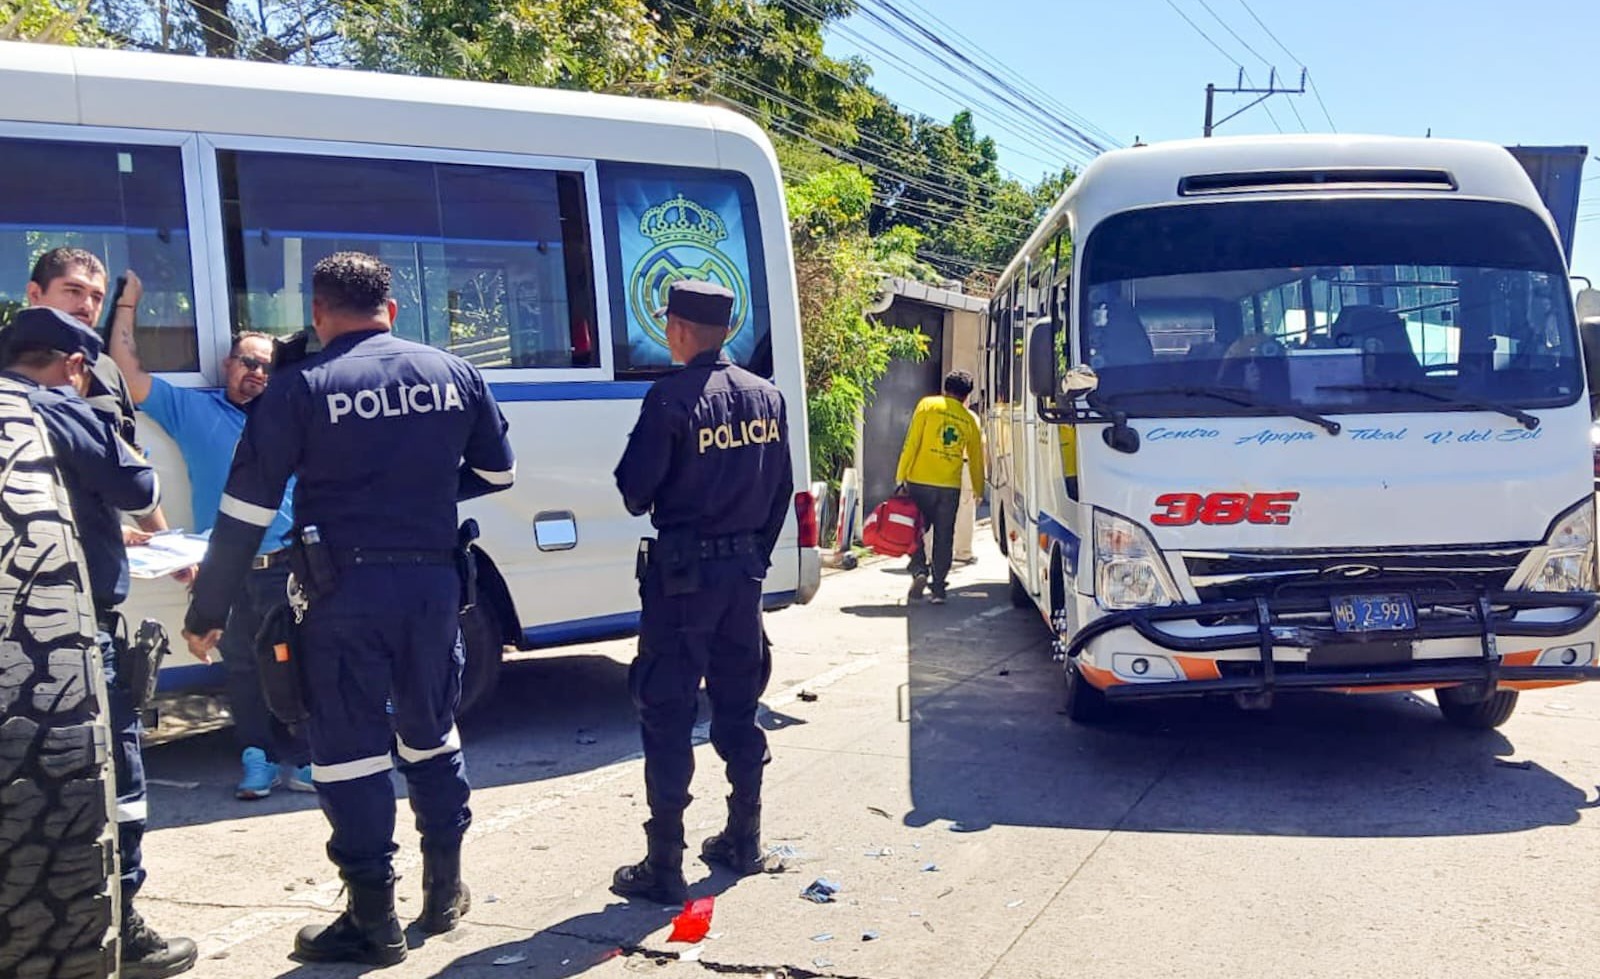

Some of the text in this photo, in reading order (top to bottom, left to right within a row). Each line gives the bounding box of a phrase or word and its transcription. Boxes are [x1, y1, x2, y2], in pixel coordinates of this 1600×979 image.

[326, 383, 465, 424] POLICIA
[698, 418, 780, 454] POLICIA
[1145, 426, 1220, 442] Centro
[1234, 428, 1318, 446] Apopa
[1347, 427, 1408, 441] Tikal
[1457, 428, 1493, 443] del
[1496, 427, 1543, 442] Sol
[1150, 491, 1300, 527] 38E
